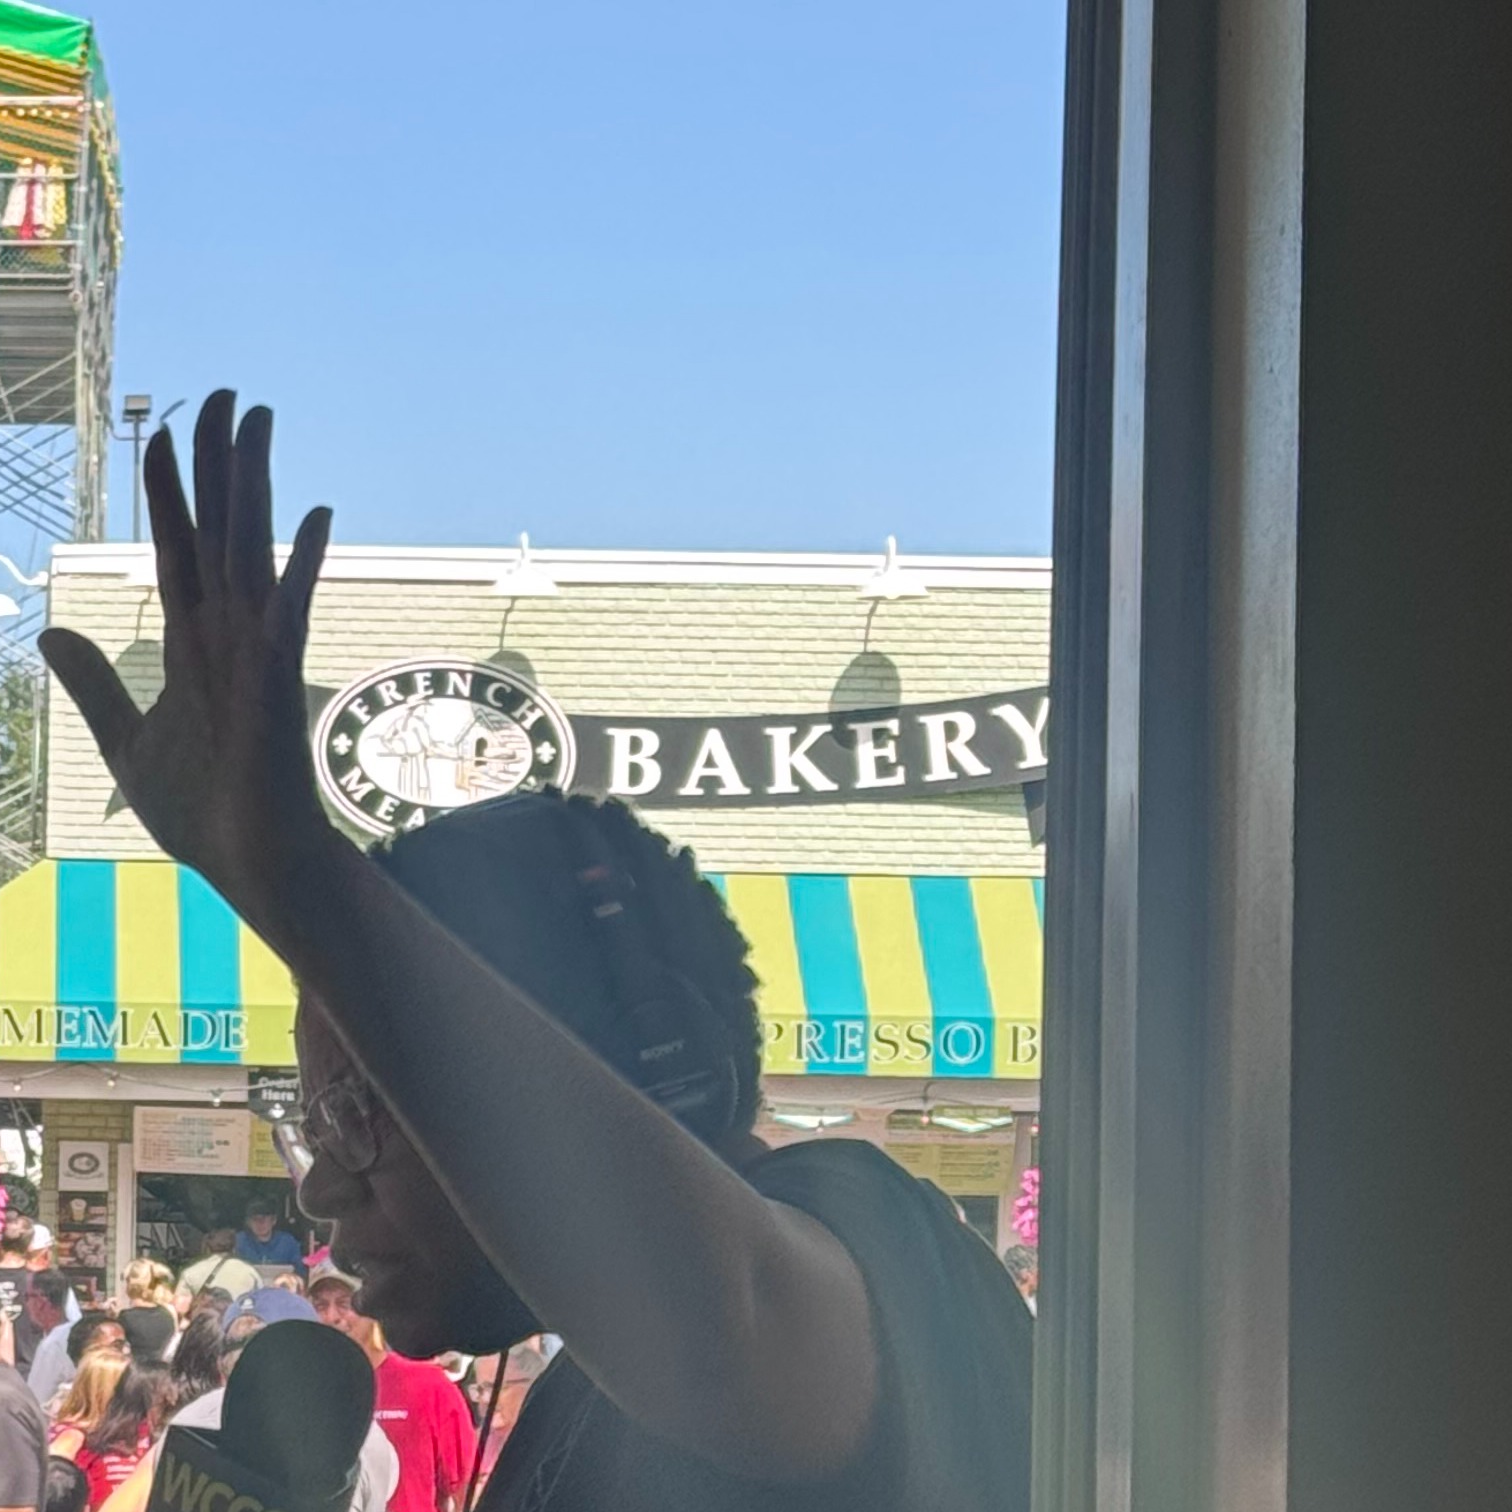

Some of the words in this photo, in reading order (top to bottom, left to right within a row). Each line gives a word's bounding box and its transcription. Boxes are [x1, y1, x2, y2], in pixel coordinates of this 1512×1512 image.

[348, 671, 545, 731] FRENCH
[607, 696, 1050, 797] BAKERY
[763, 1019, 987, 1066] PRESSO
